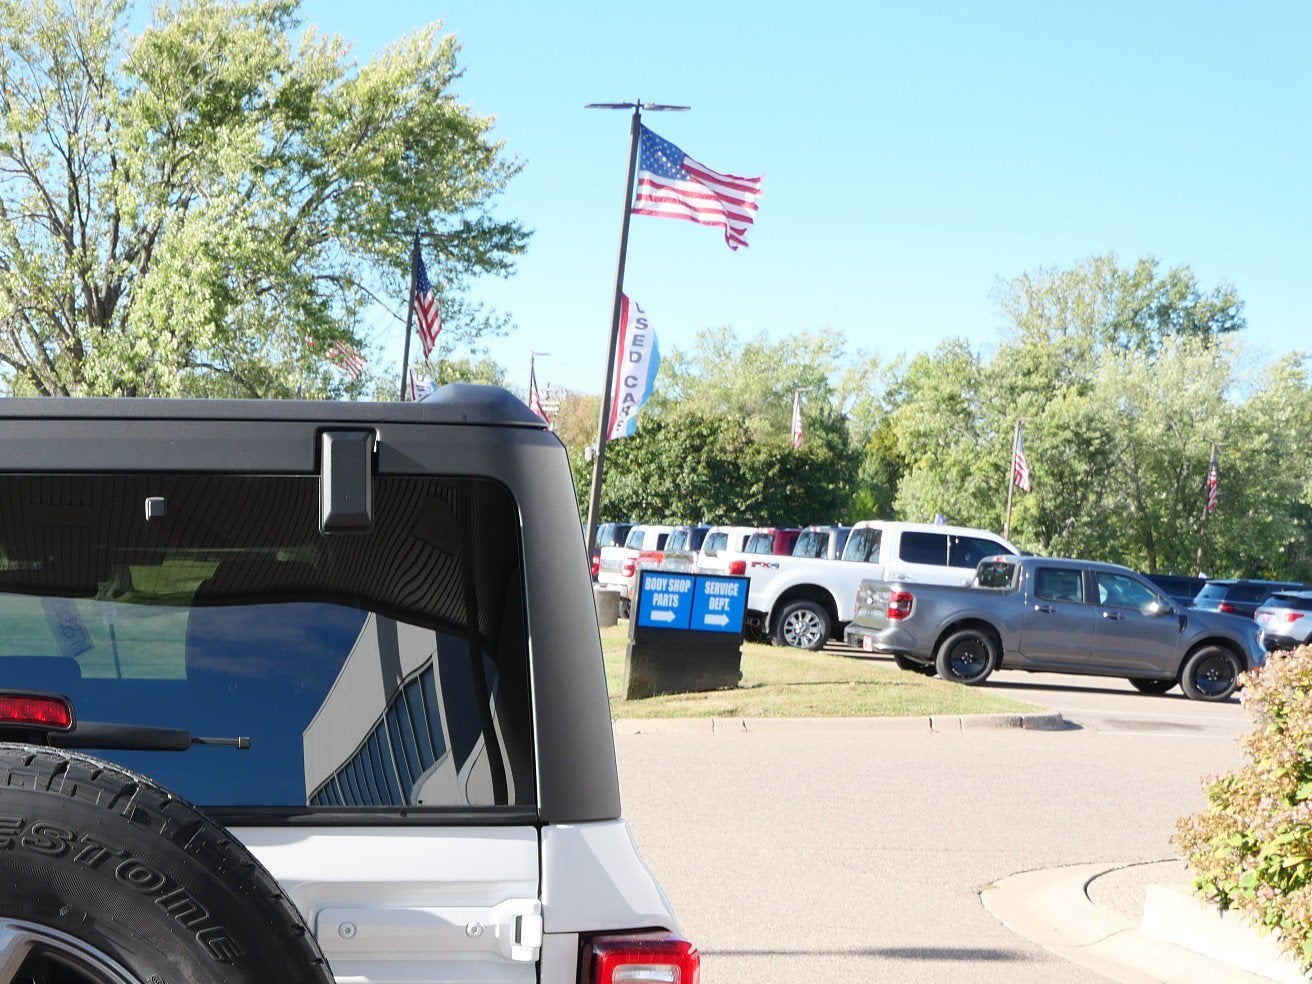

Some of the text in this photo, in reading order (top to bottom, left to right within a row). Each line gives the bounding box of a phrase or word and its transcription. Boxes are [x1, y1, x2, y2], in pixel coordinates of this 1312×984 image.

[645, 577, 691, 593] BODY SHOP
[704, 581, 739, 596] SERVICE
[652, 593, 679, 608] PARTS
[708, 597, 730, 611] DEPT.
